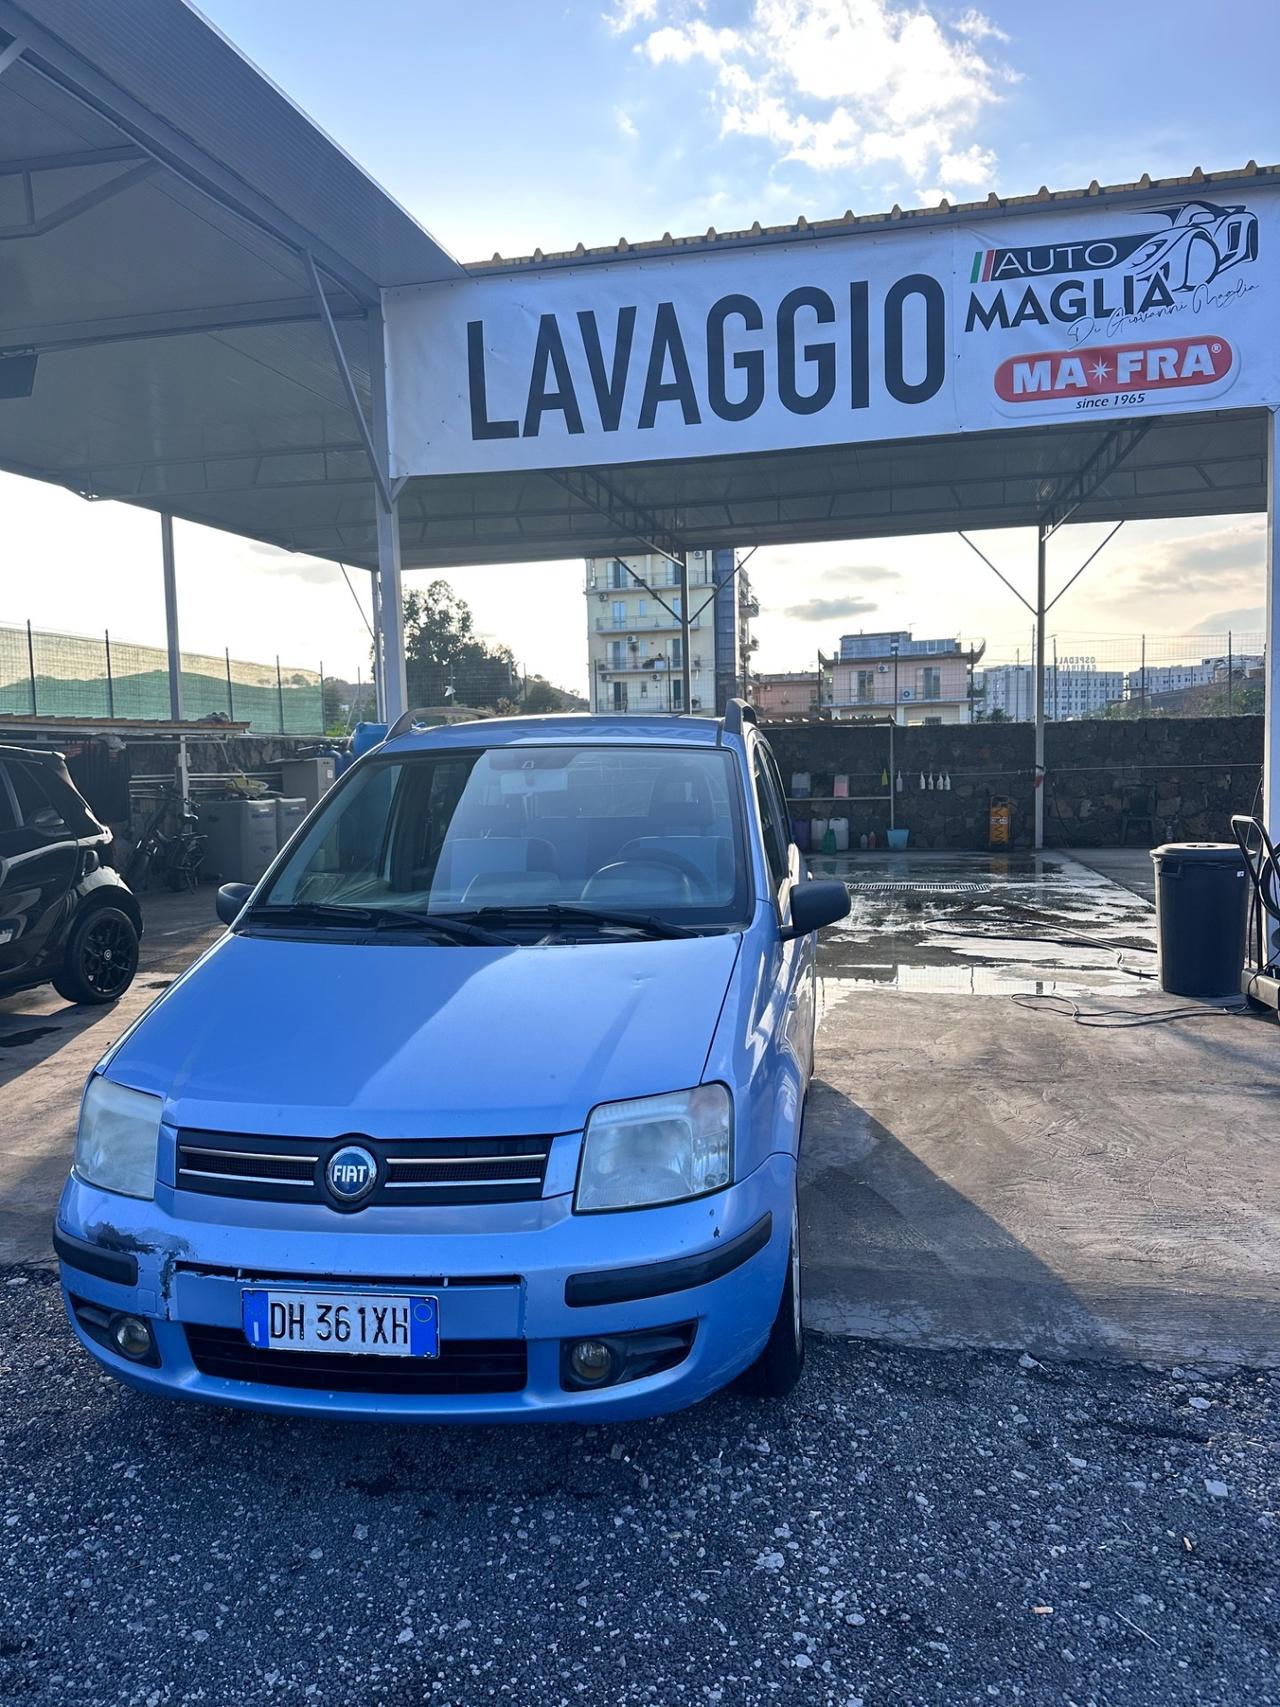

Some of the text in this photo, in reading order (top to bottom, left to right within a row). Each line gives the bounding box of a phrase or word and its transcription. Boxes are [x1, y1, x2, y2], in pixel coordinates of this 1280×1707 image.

[994, 242, 1118, 277] AUTO
[964, 271, 1176, 333] MAGLIA
[1106, 303, 1188, 338] Giovanni
[467, 273, 945, 441] LAVAGGIO
[1075, 392, 1146, 409] since 1965
[333, 1164, 367, 1183] FIAT
[270, 1302, 408, 1344] DH 361XH
